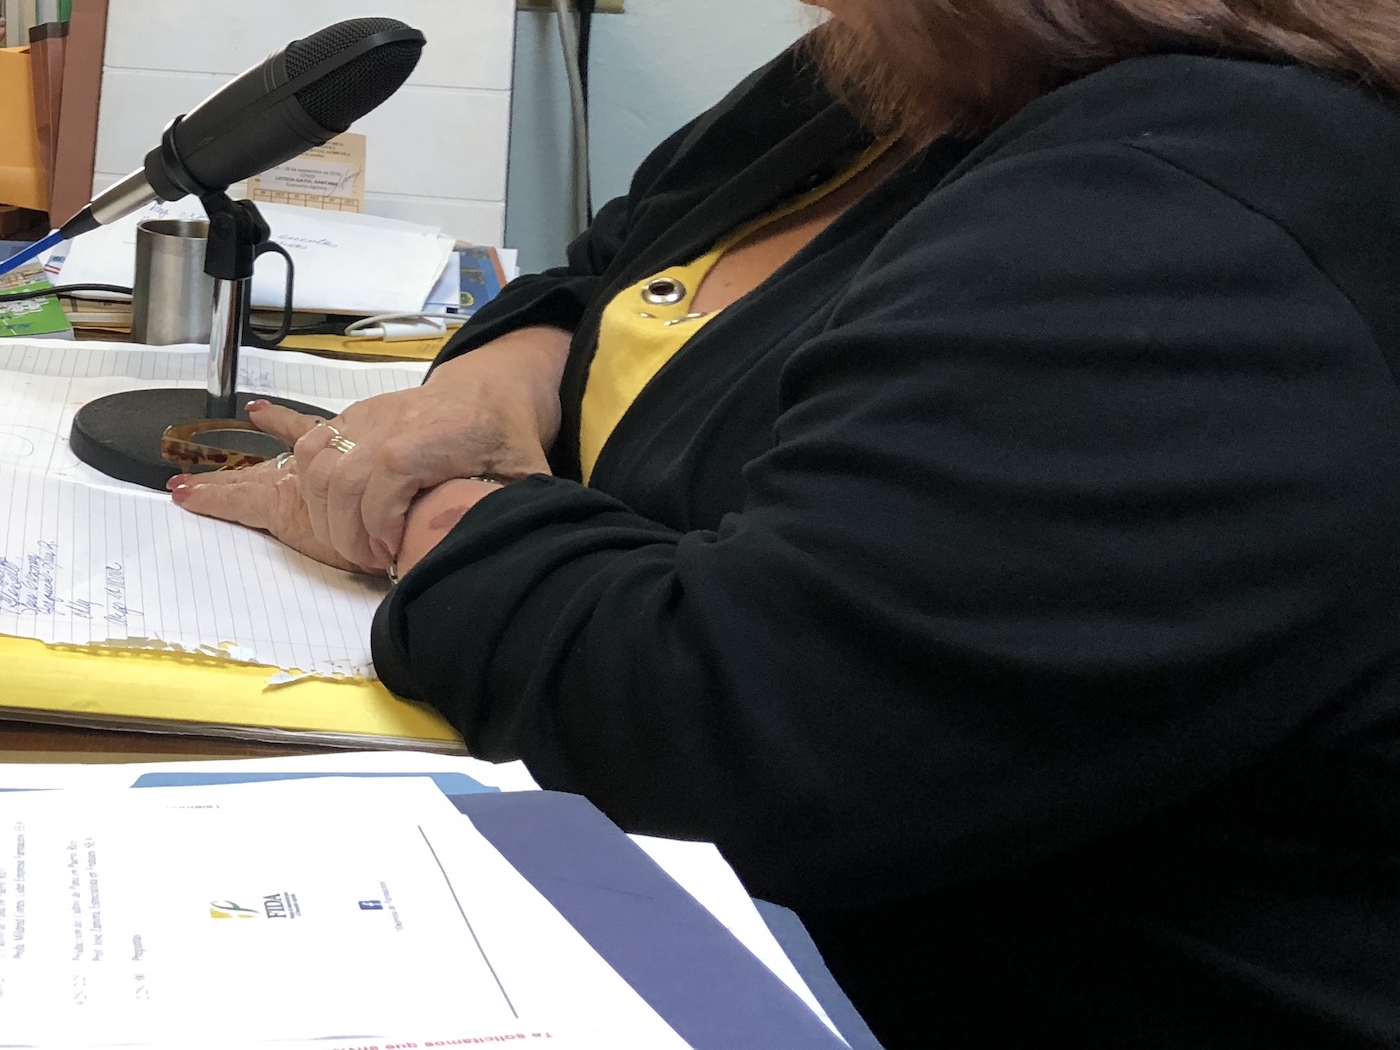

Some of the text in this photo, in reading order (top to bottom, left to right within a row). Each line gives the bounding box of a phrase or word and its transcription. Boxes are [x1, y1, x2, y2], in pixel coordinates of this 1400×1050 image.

[259, 890, 289, 921] FIDA
[383, 1041, 419, 1050] que
[423, 1033, 526, 1048] solicitamos
